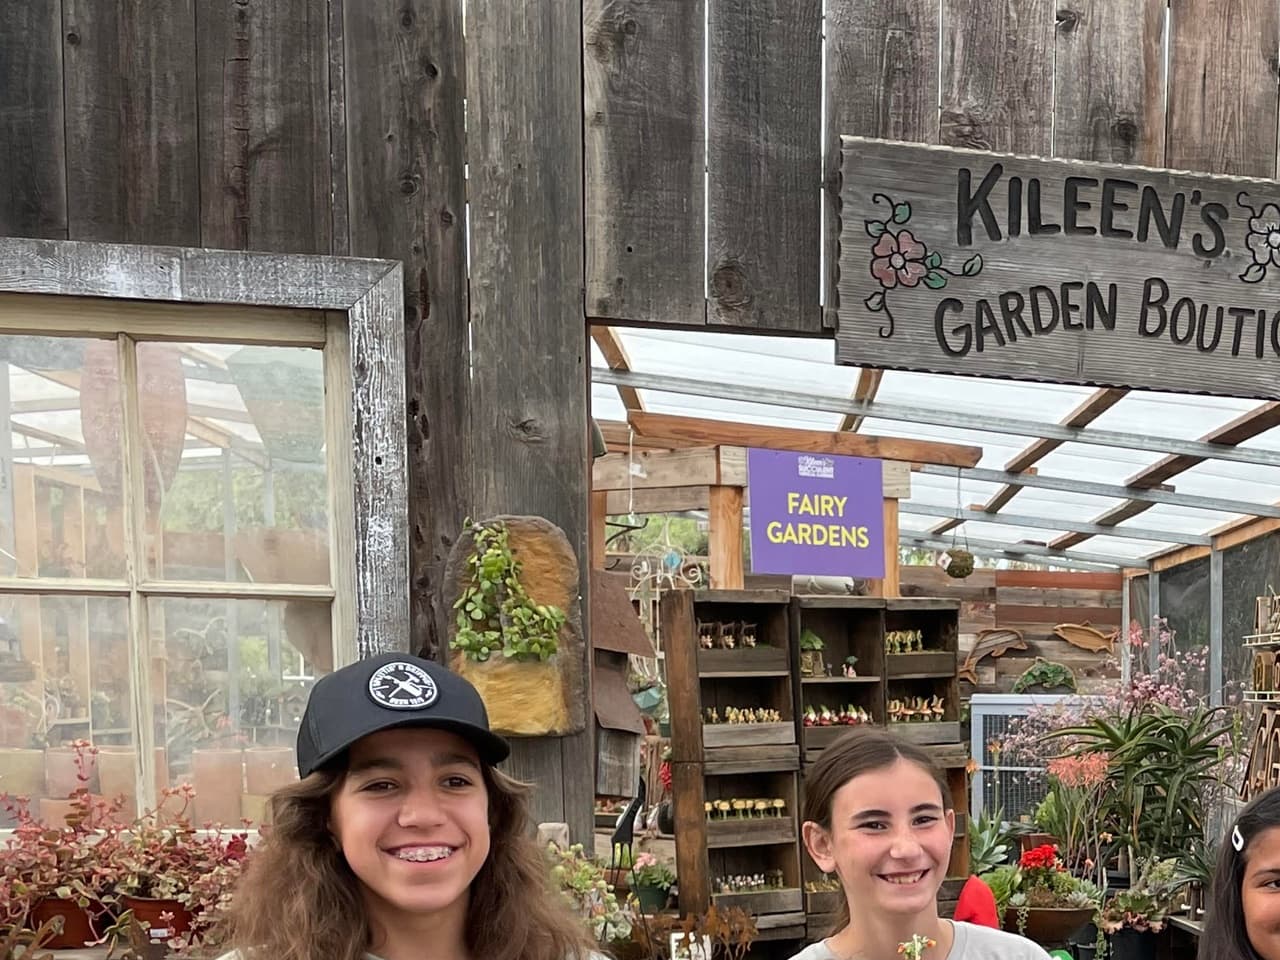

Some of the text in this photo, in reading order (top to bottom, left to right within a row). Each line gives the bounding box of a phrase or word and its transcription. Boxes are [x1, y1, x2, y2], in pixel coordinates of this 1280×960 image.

[956, 163, 1229, 258] KILEEN'S
[935, 281, 1117, 356] GARDEN
[787, 493, 848, 517] FAIRY
[767, 521, 870, 548] GARDENS
